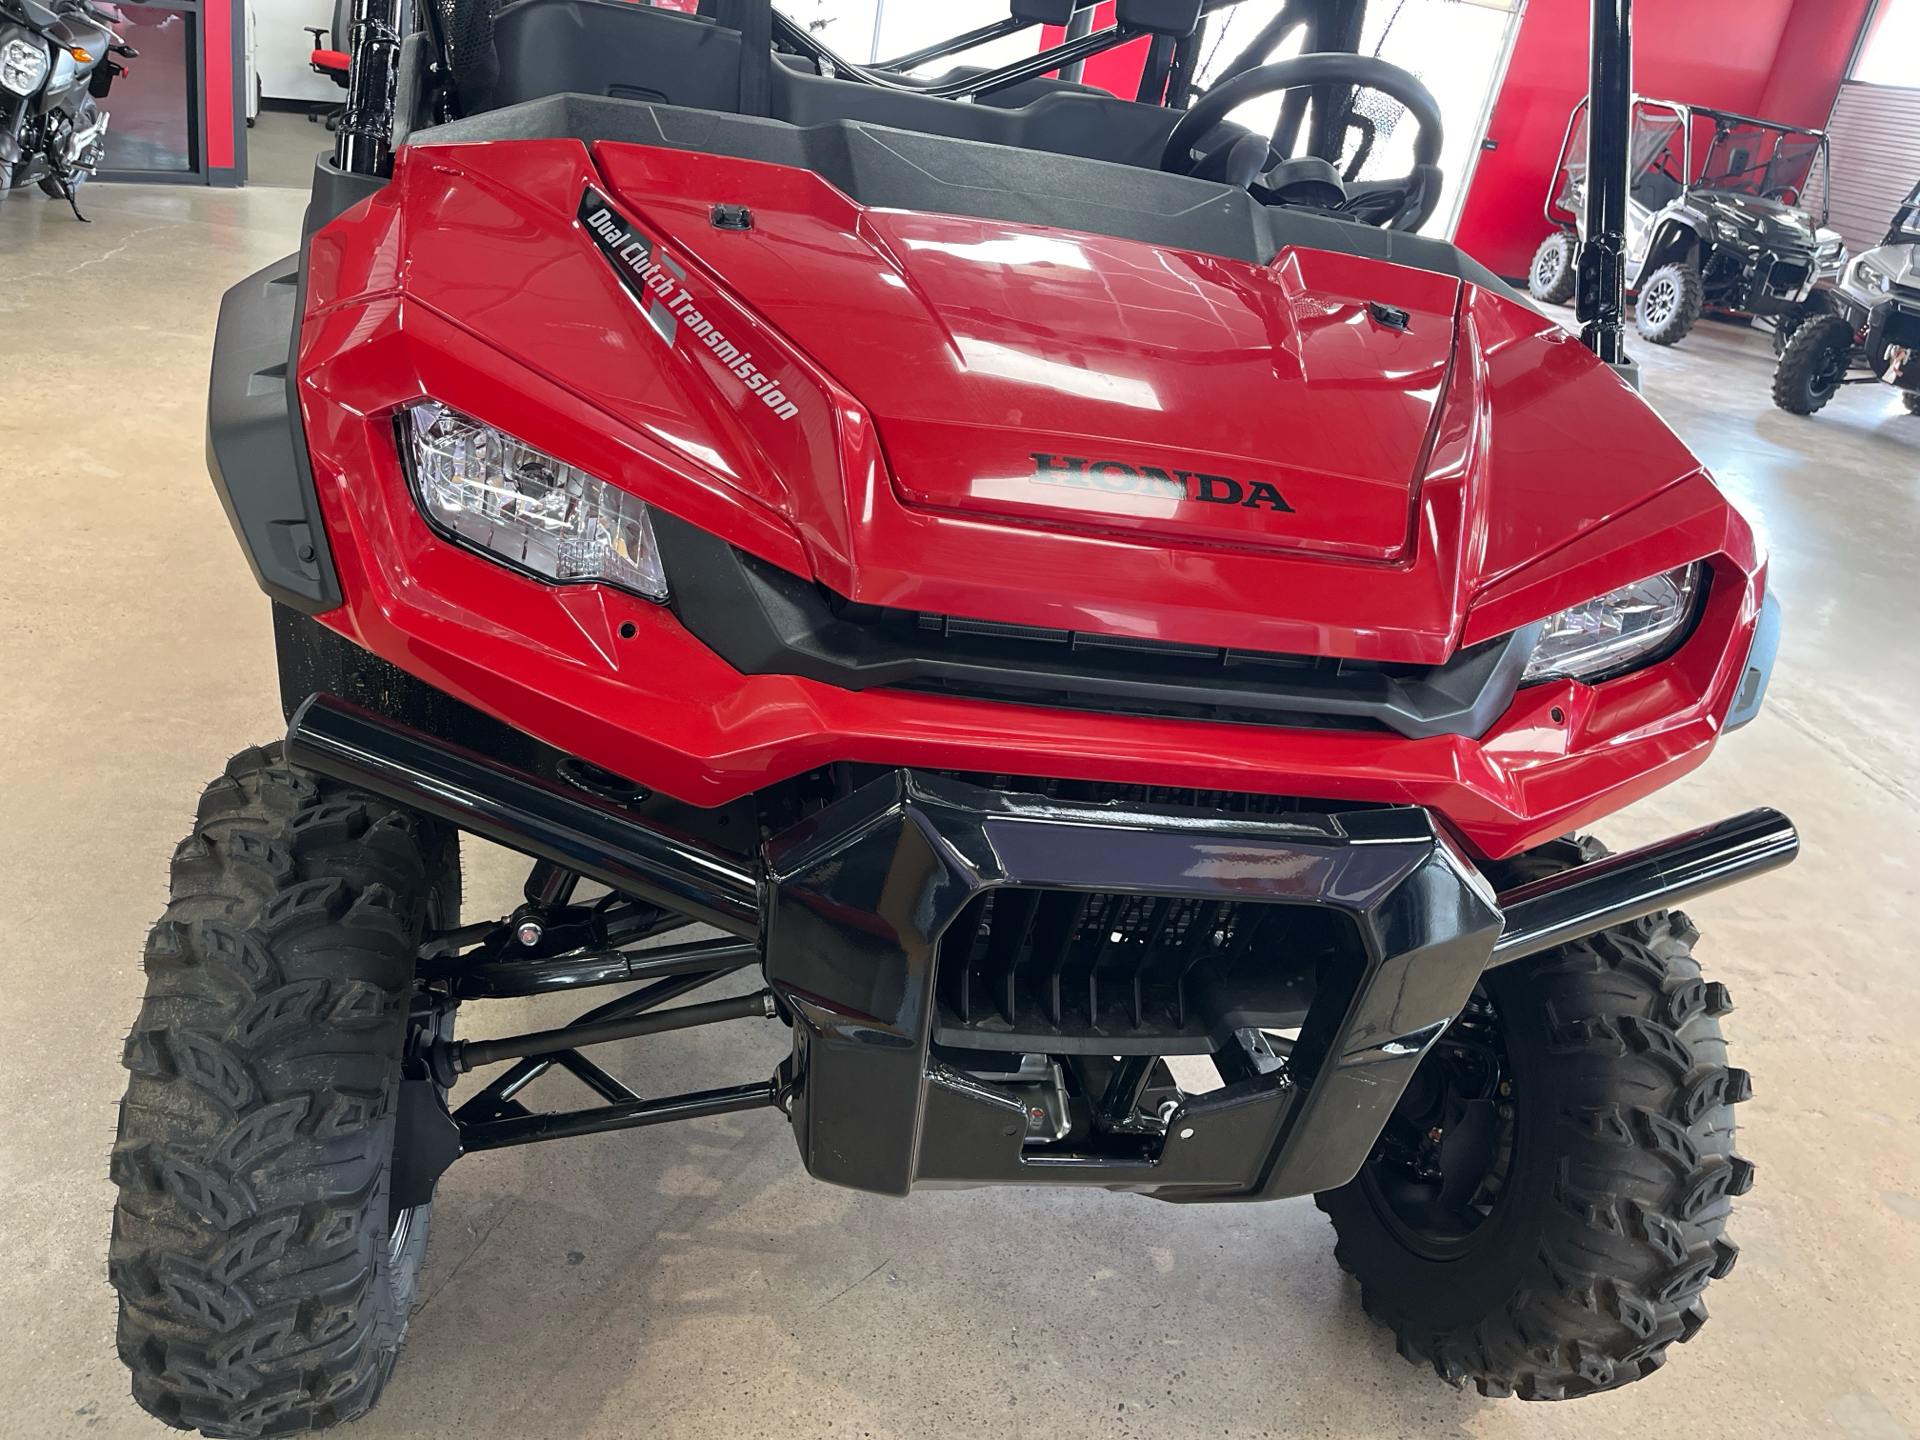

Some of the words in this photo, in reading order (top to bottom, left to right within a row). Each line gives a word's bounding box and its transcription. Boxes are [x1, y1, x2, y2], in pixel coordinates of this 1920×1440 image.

[587, 208, 631, 248] Dual
[619, 242, 675, 298] Clutch
[668, 288, 799, 421] Transmission
[1030, 453, 1296, 513] HONDA
